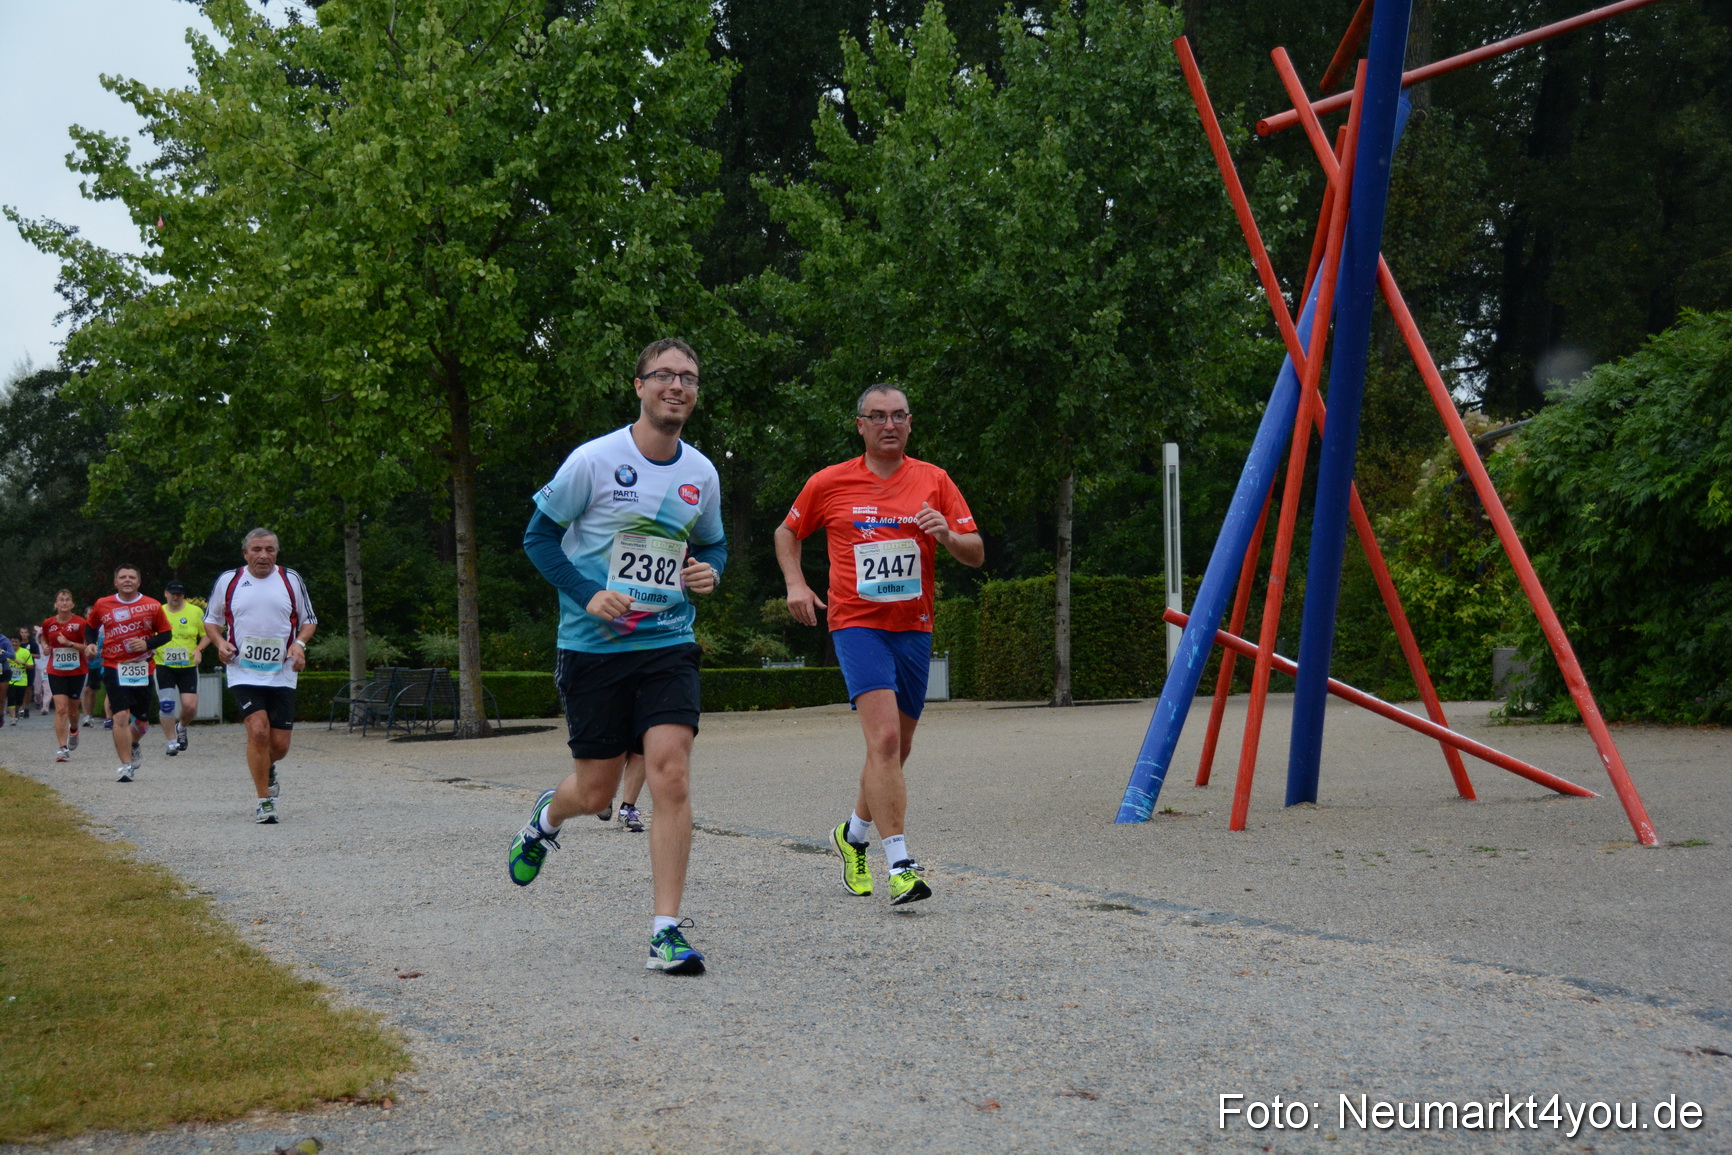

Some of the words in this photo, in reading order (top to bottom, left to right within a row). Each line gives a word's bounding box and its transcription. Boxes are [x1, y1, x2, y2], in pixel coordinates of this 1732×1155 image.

[613, 490, 639, 498] PARTL
[879, 516, 896, 524] Mai
[897, 516, 919, 524] 2006
[884, 541, 914, 550] BOCK
[618, 552, 677, 586] 2382
[863, 554, 916, 581] 2447
[877, 584, 905, 594] Lothar
[628, 587, 668, 603] Thomas
[56, 652, 78, 662] 2086
[166, 651, 187, 661] 2911
[245, 645, 281, 662] 3062
[121, 665, 146, 677] 2355
